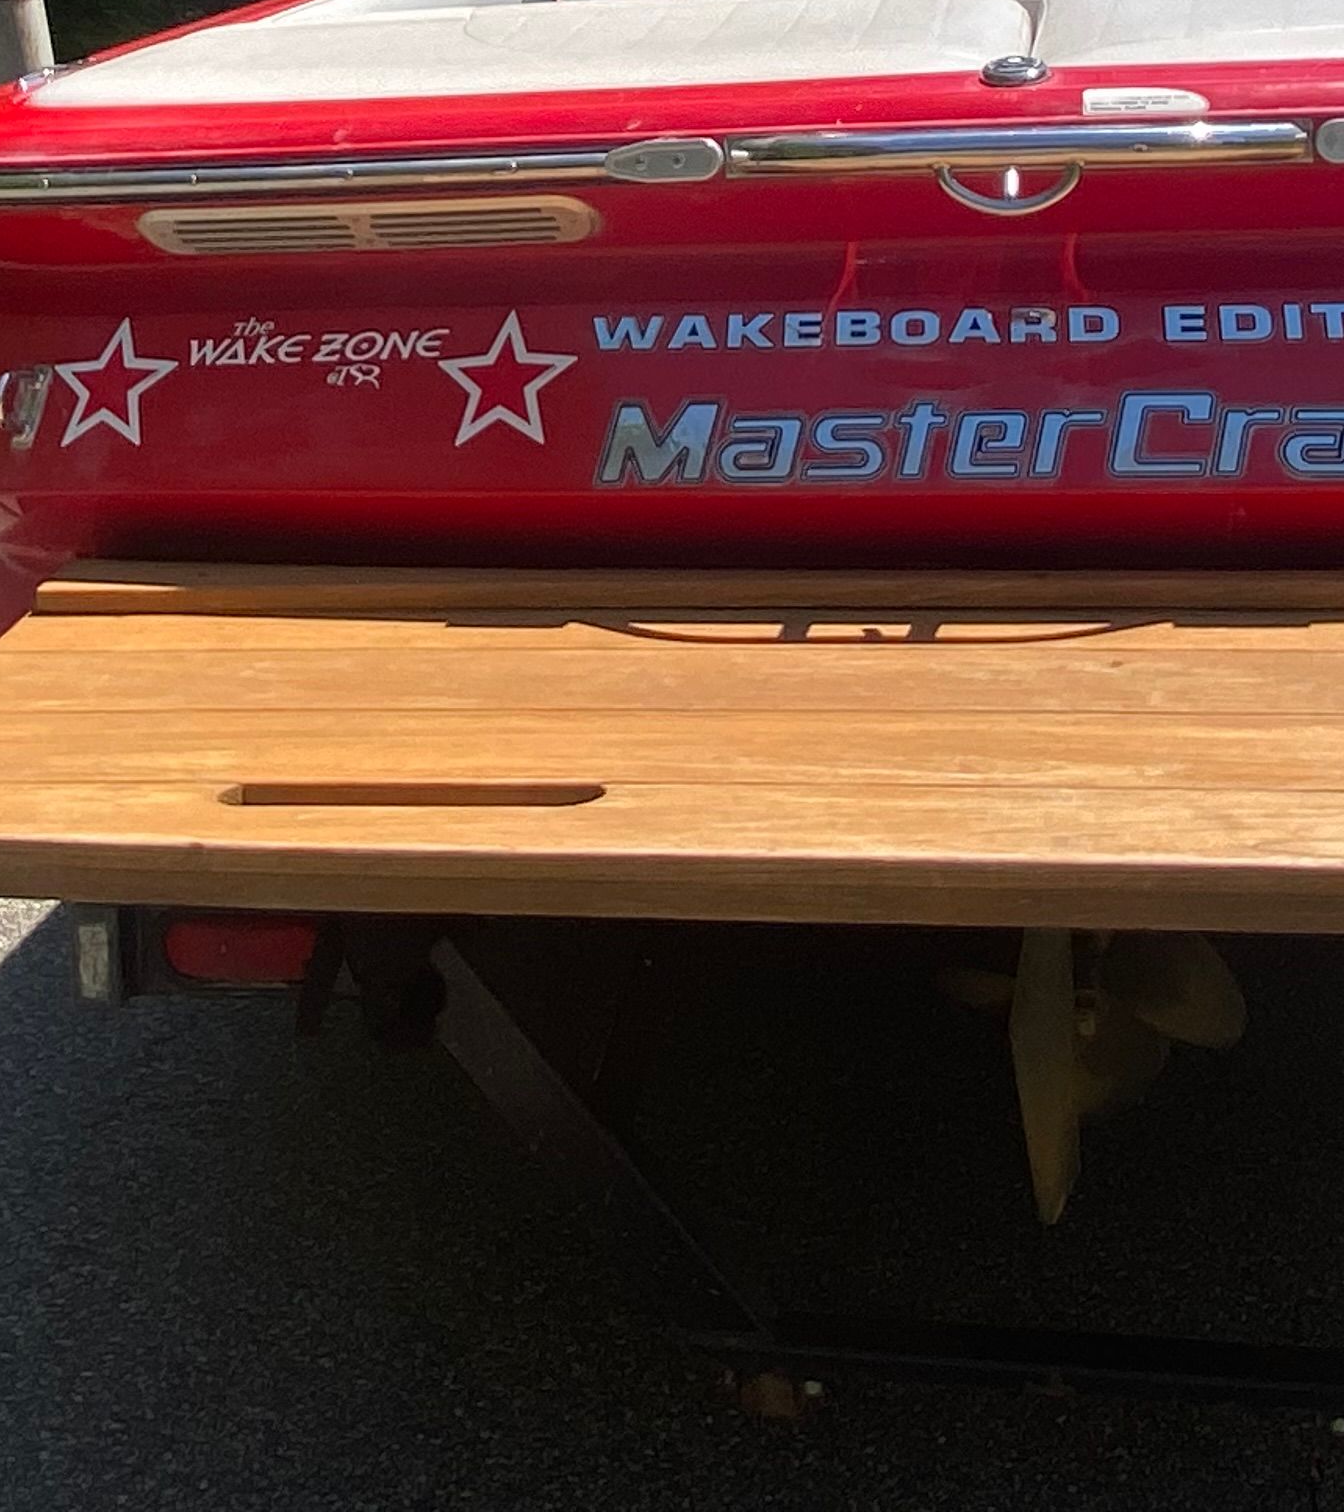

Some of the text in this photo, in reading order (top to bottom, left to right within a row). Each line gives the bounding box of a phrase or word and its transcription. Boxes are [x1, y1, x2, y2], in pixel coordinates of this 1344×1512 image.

[190, 329, 450, 366] WAKE ZONE
[592, 306, 1120, 351] WAKEBOARD
